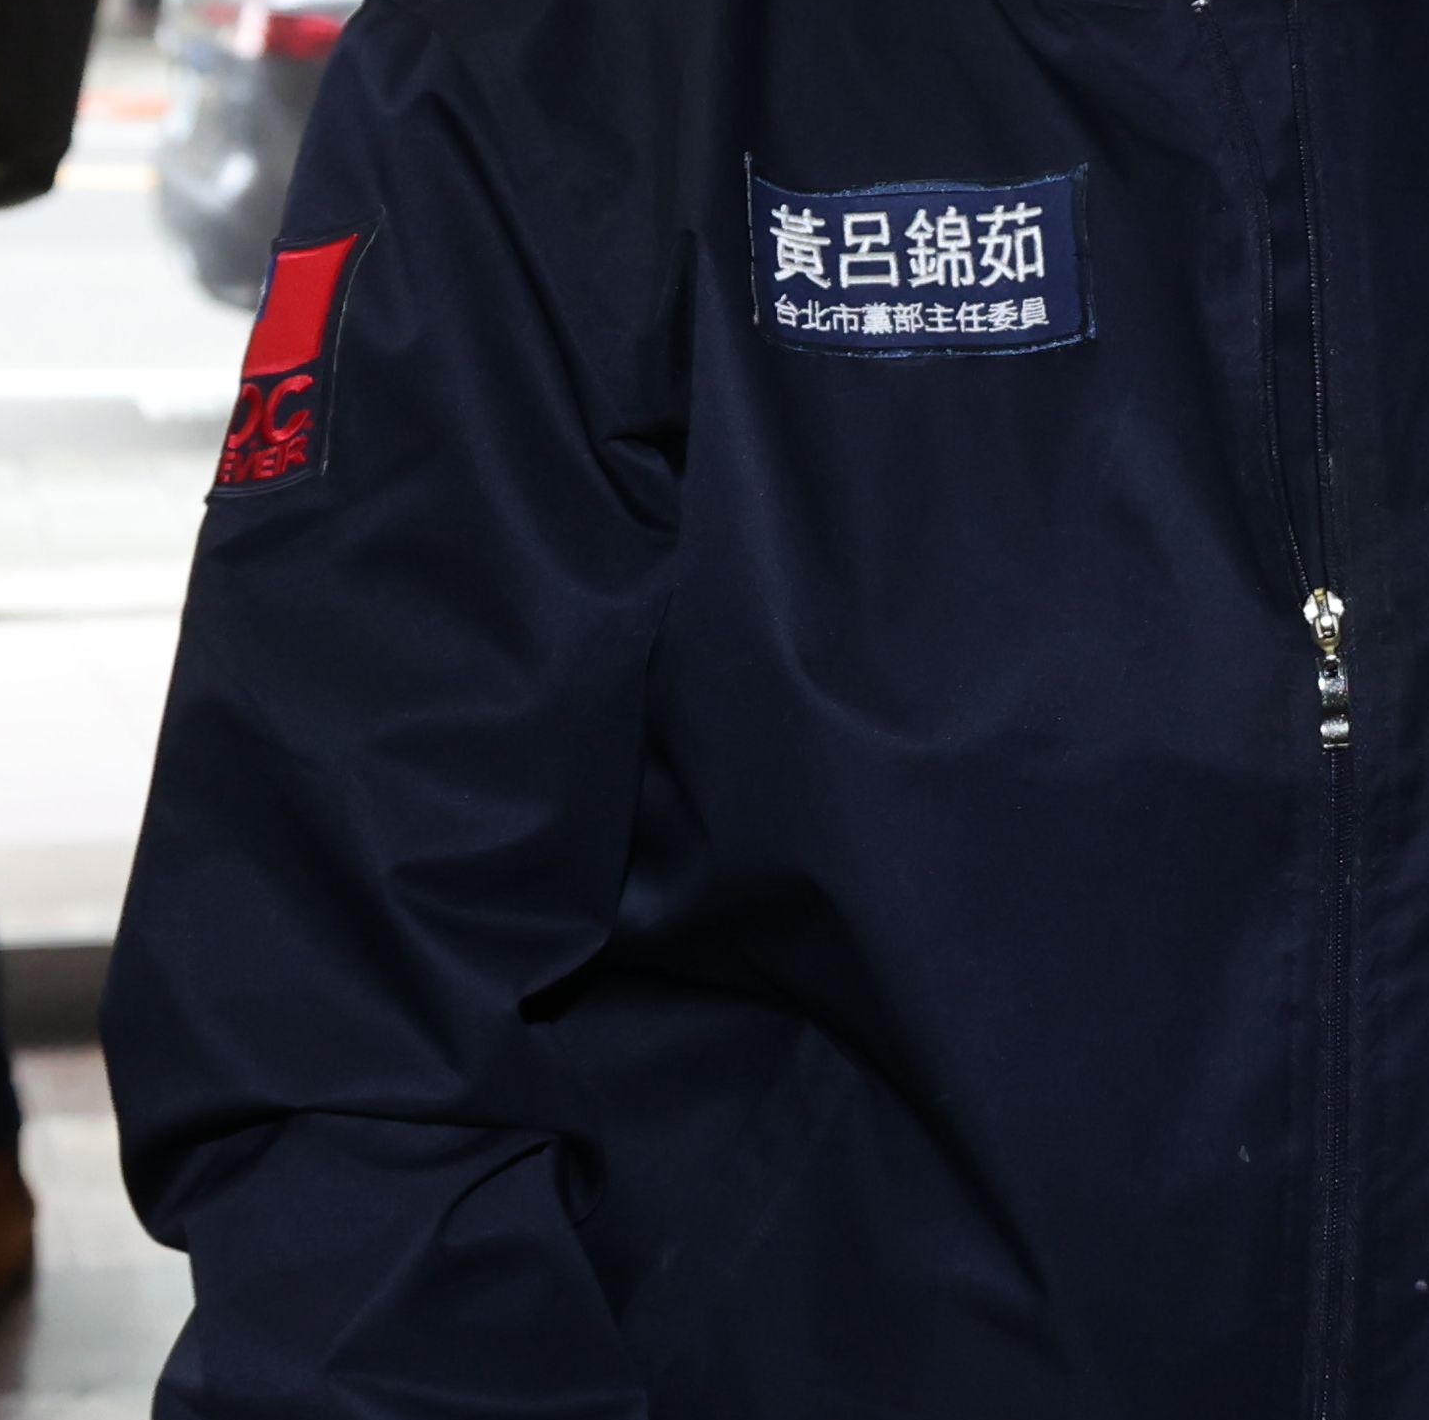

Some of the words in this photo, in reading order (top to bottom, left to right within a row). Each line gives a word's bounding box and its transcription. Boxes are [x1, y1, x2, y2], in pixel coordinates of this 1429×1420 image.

[769, 202, 1046, 290] 黃呂錦茹
[773, 293, 1051, 336] 台北市黨部主任委員
